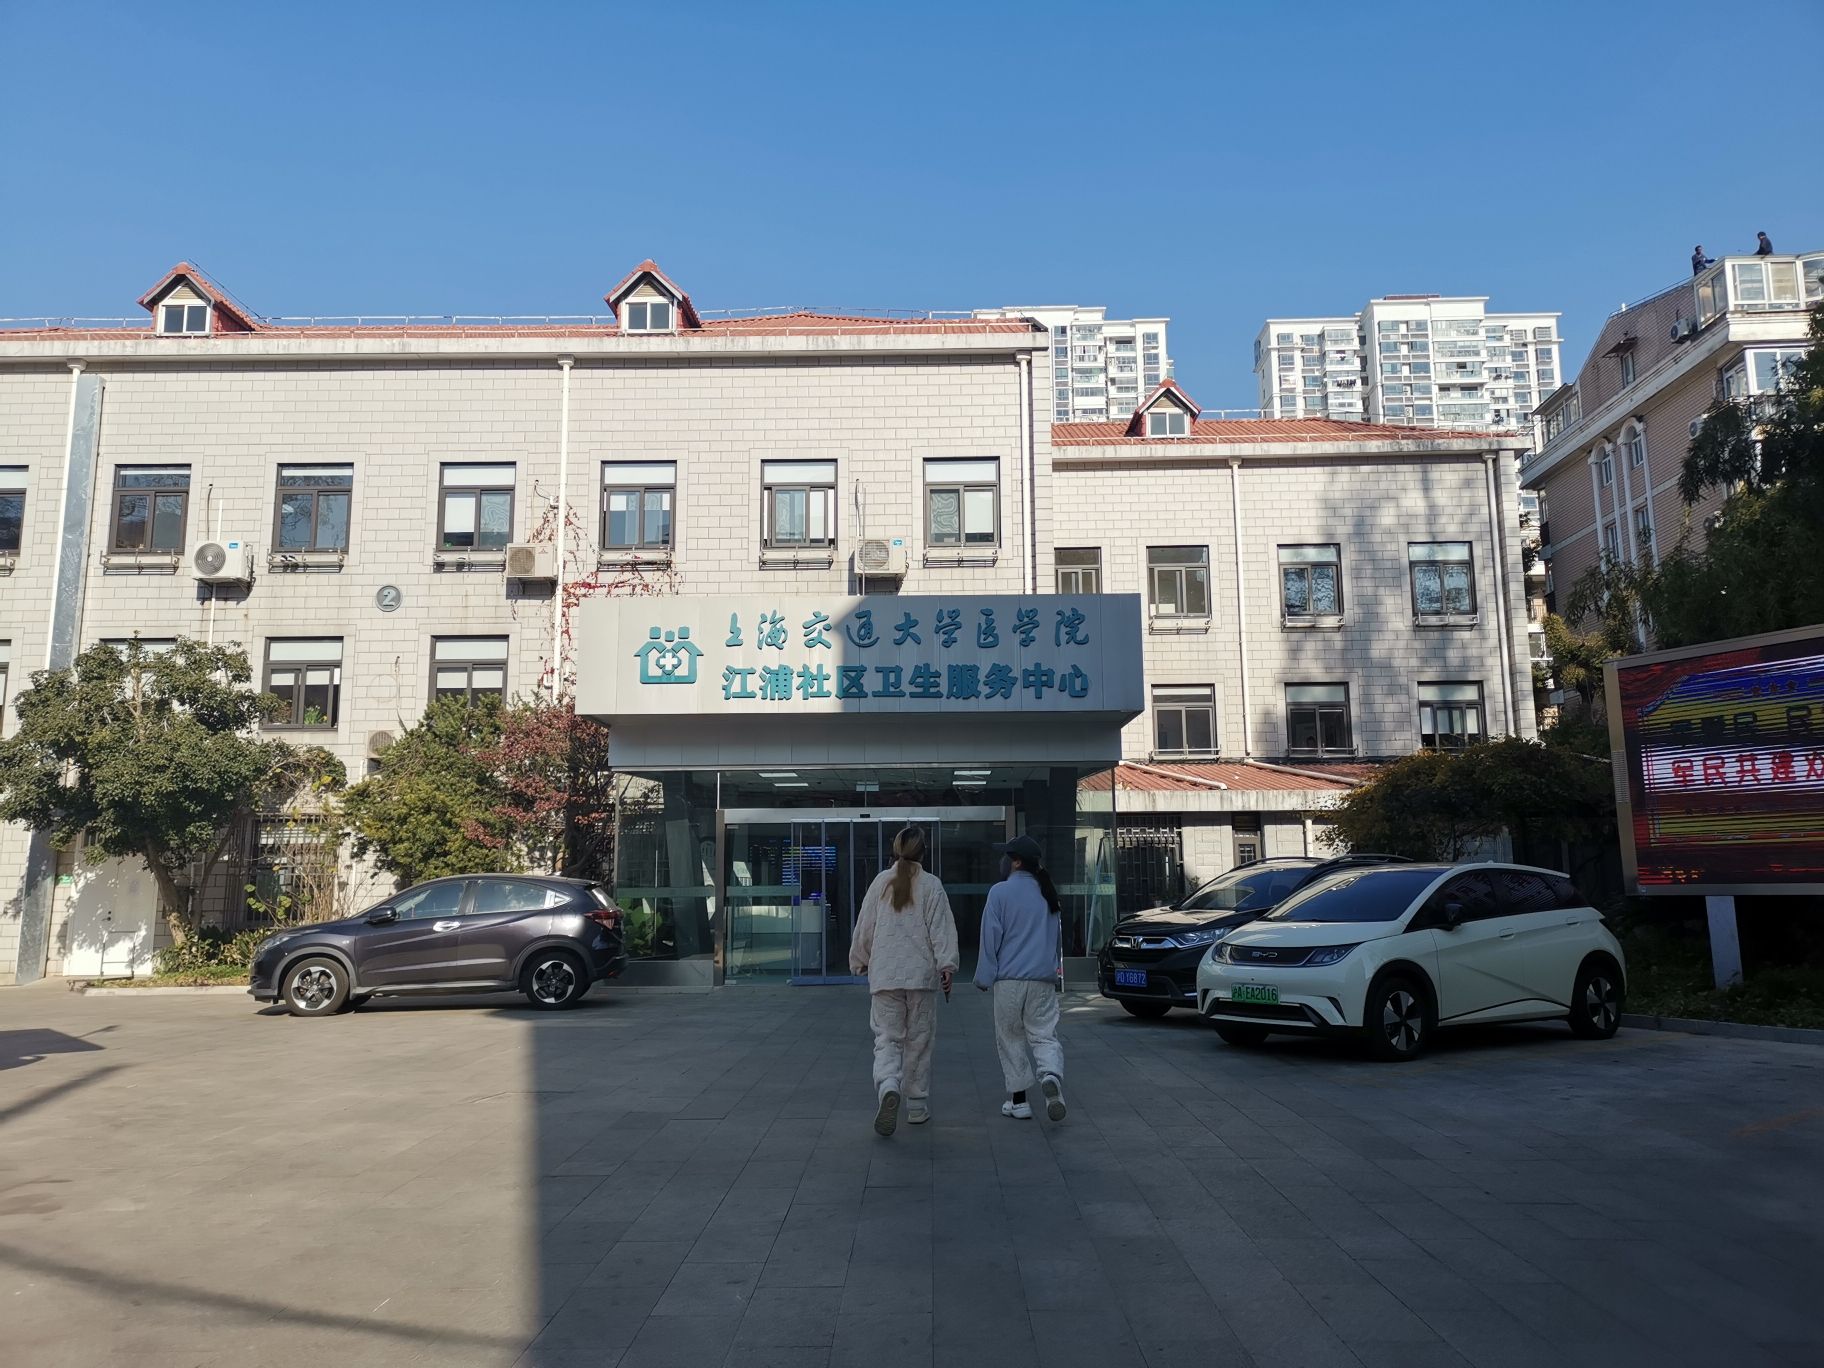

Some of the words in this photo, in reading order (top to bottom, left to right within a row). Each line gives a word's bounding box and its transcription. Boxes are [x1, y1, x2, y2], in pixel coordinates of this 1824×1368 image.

[382, 588, 397, 607] 2
[725, 607, 1090, 651] 上海交通大学医学院
[721, 662, 1090, 700] 江浦社区卫生服务中心
